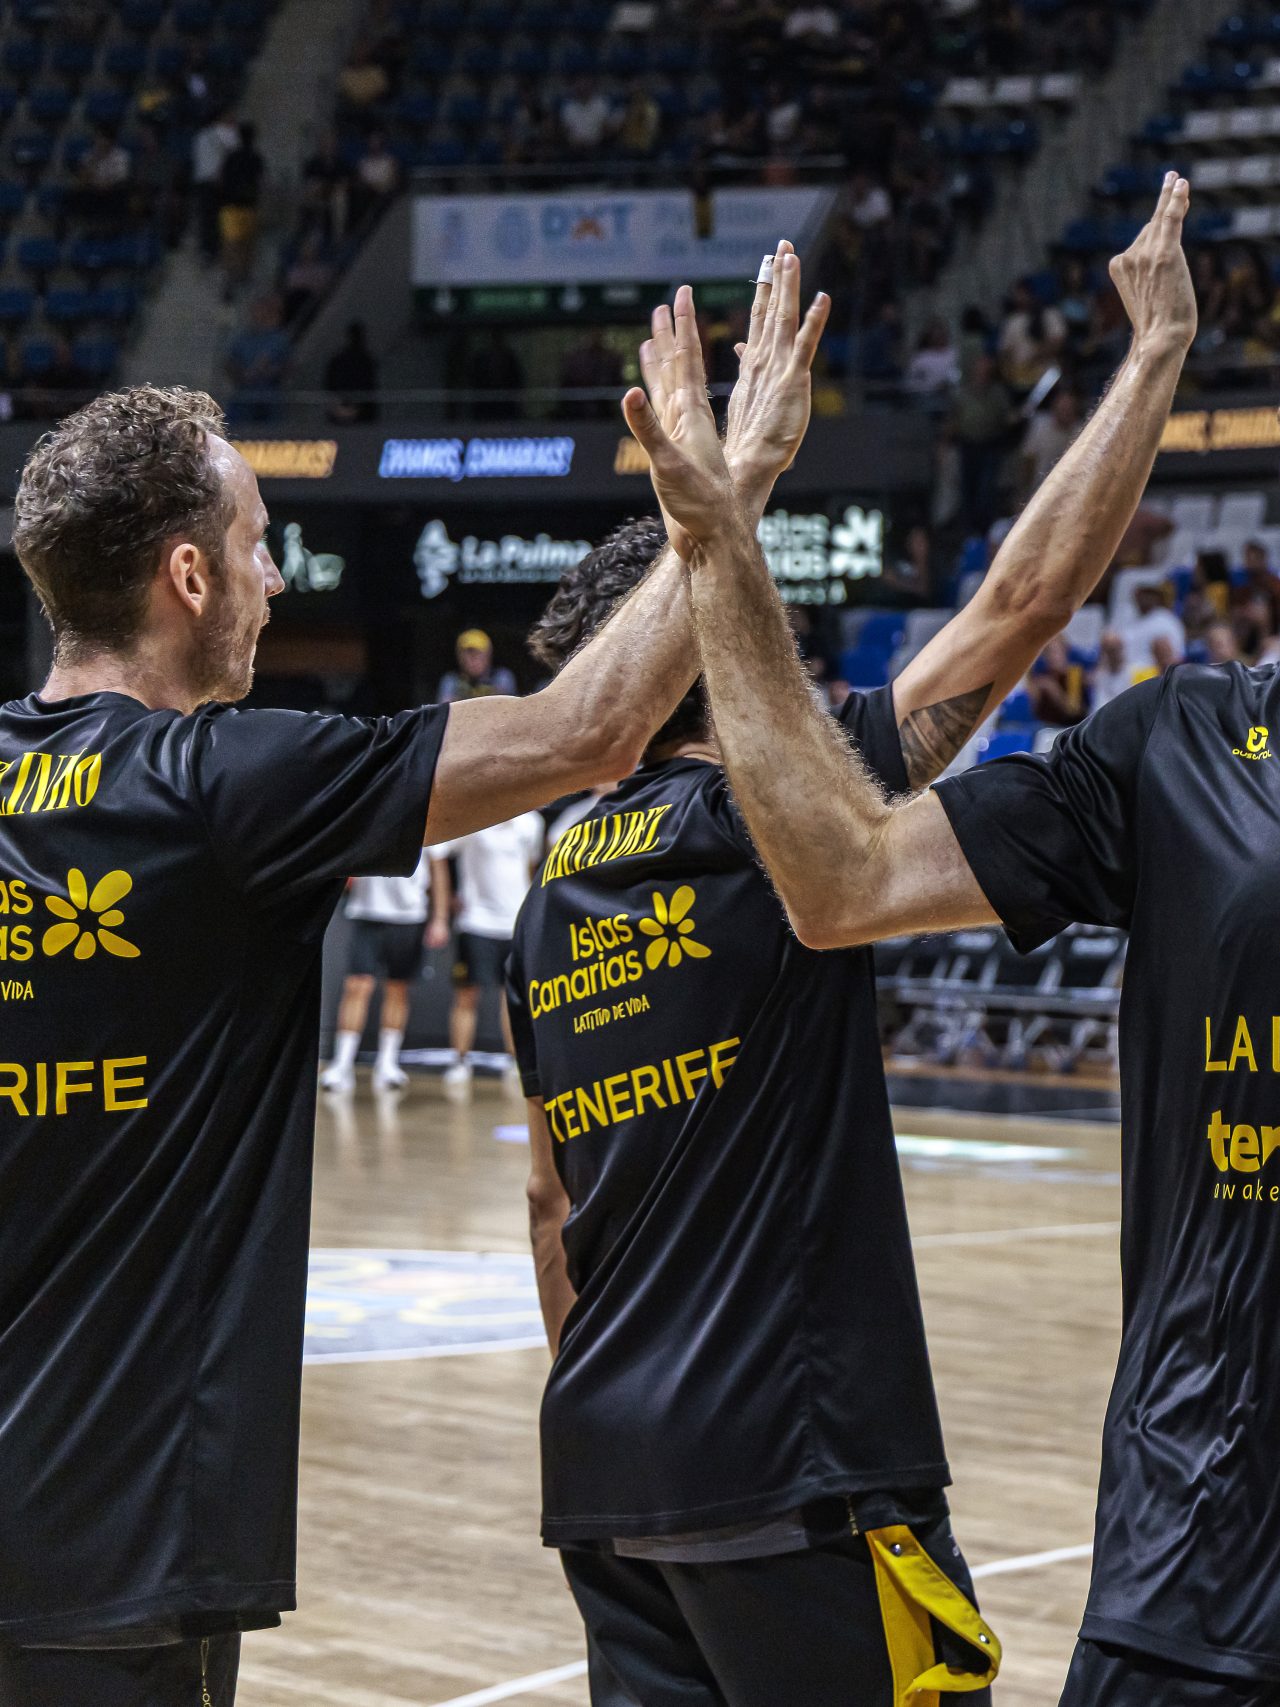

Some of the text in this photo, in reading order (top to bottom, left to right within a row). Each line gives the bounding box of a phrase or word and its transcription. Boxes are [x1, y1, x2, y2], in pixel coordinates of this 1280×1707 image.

[569, 913, 634, 961] Islas
[1, 980, 34, 1000] VIDA
[529, 949, 643, 1020] Canarias
[573, 994, 651, 1034] LATITUD DE VIDA
[1205, 1015, 1258, 1072] LA
